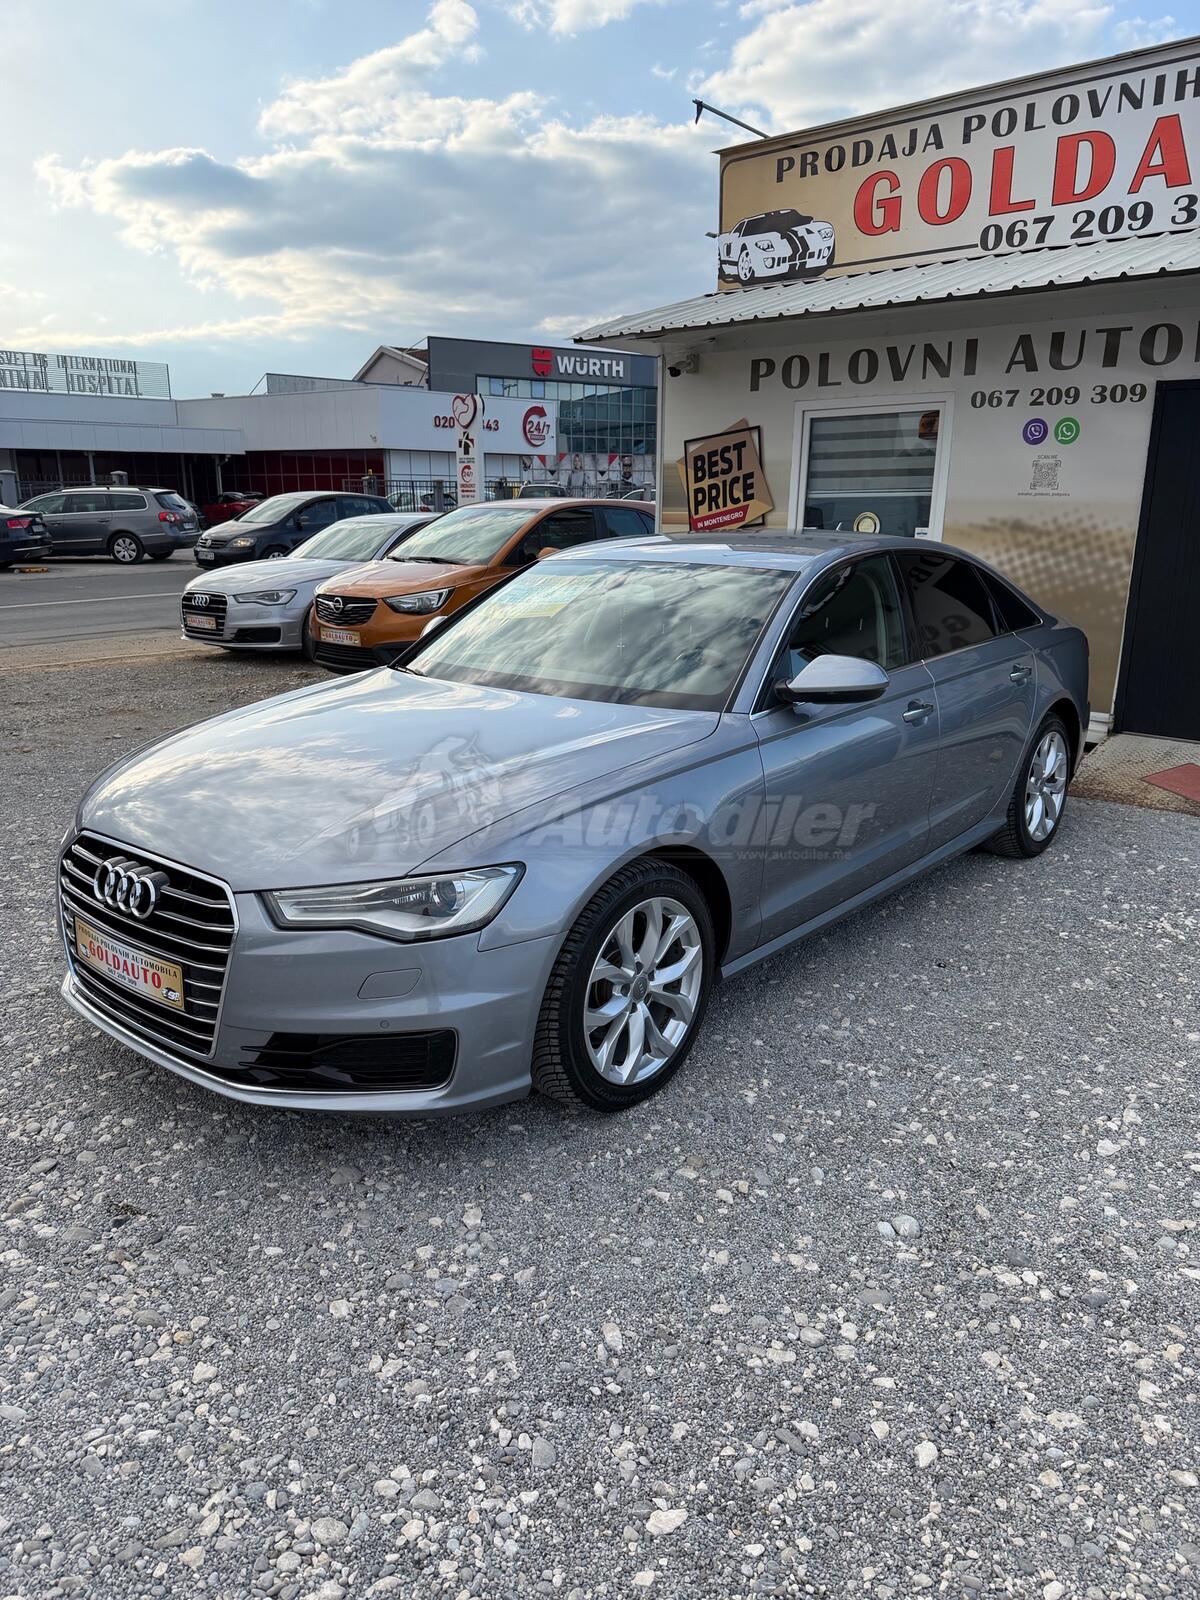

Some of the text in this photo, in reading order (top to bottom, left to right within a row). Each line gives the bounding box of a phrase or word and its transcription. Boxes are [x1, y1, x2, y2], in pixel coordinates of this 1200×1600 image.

[775, 123, 945, 184] PRODAJA
[853, 112, 1193, 237] GOLDA
[979, 214, 1056, 252] 067
[1070, 200, 1154, 241] 209
[557, 355, 625, 378] WÜRTH
[748, 319, 1200, 392] POLOVNI AUTO
[970, 382, 1148, 409] 067 209 309
[433, 415, 456, 429] 020
[527, 420, 551, 434] 24/7
[693, 440, 747, 485] BEST
[693, 471, 755, 516] PRICE
[703, 511, 744, 527] MONTENEGRO
[88, 940, 162, 989] GOLDAUTO
[131, 954, 178, 979] AUTOMOBILA
